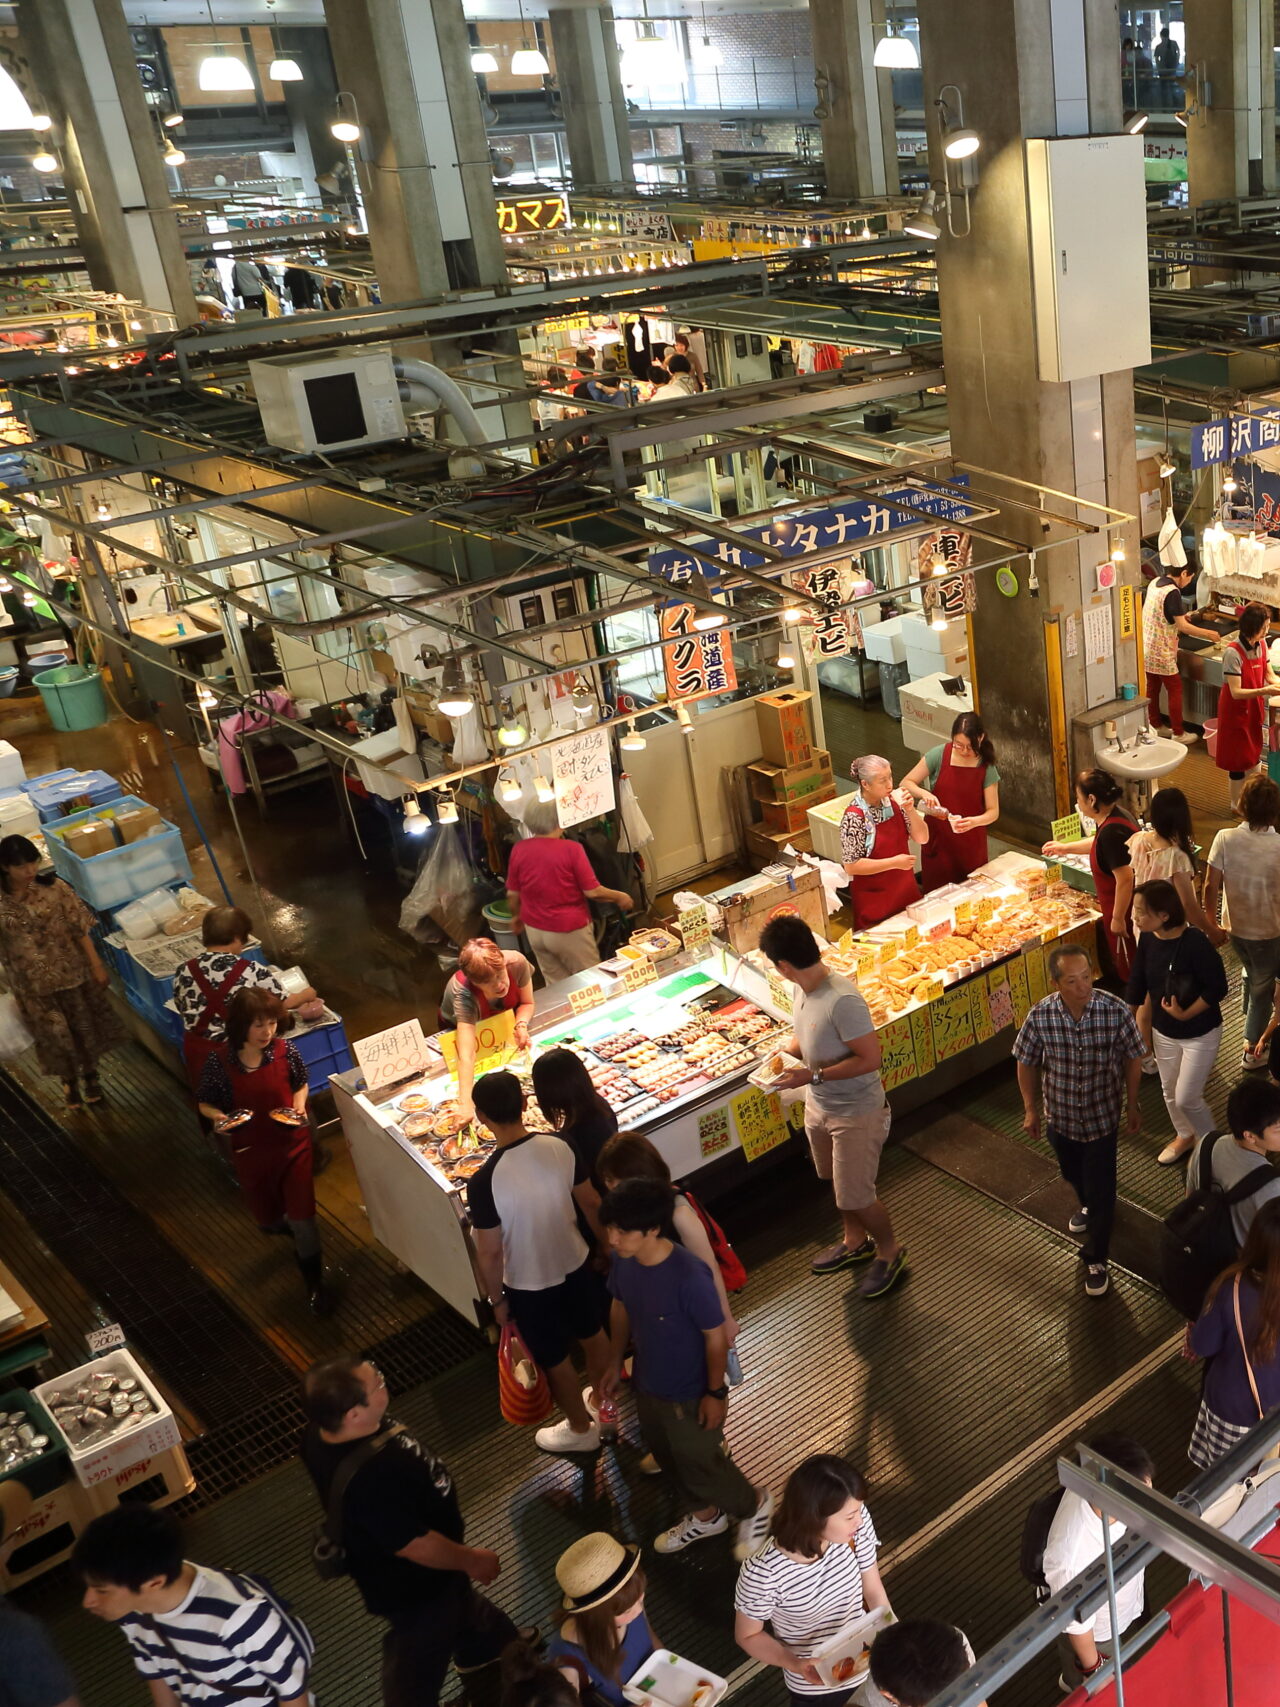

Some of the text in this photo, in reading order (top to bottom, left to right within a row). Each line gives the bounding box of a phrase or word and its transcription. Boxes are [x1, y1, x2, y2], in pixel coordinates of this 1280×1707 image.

[496, 198, 565, 233] カマス
[806, 565, 849, 656] 伊勢エビ
[669, 604, 702, 695] イクラ
[700, 632, 728, 691] 海道産
